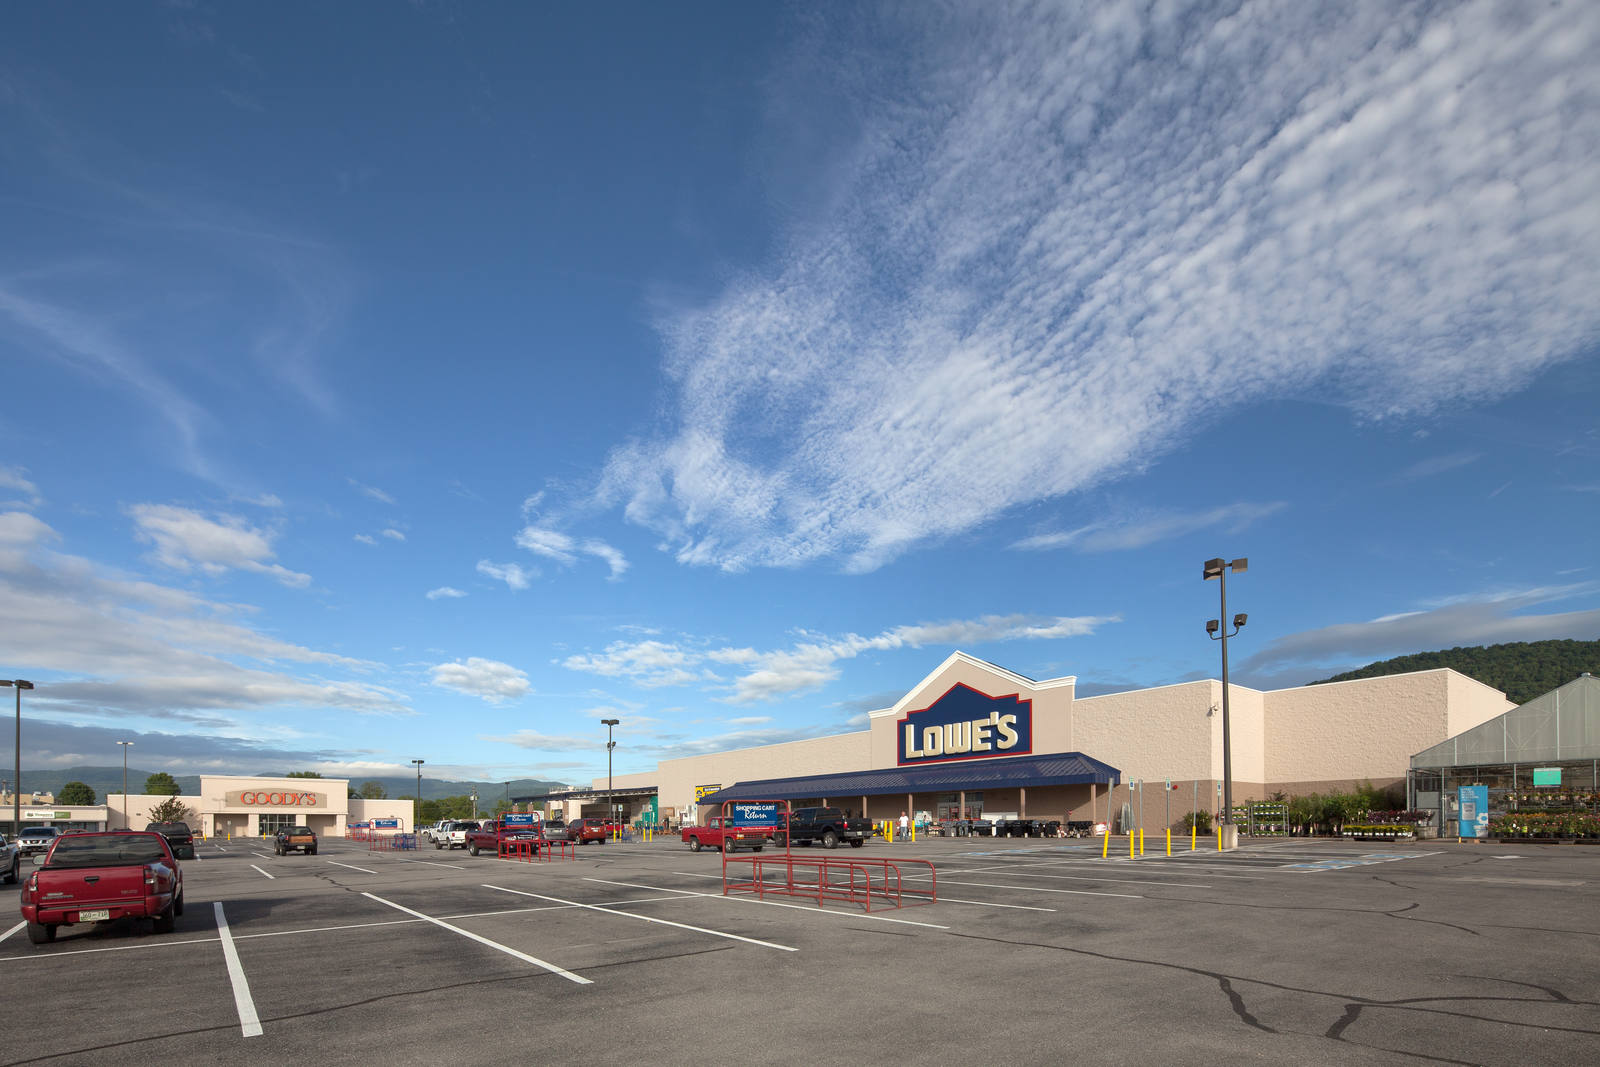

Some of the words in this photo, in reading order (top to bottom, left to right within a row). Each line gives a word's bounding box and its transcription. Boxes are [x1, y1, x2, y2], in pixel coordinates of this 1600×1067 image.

[905, 711, 1018, 759] LOWE'S
[240, 792, 316, 806] GOODY'S
[744, 809, 768, 819] Return
